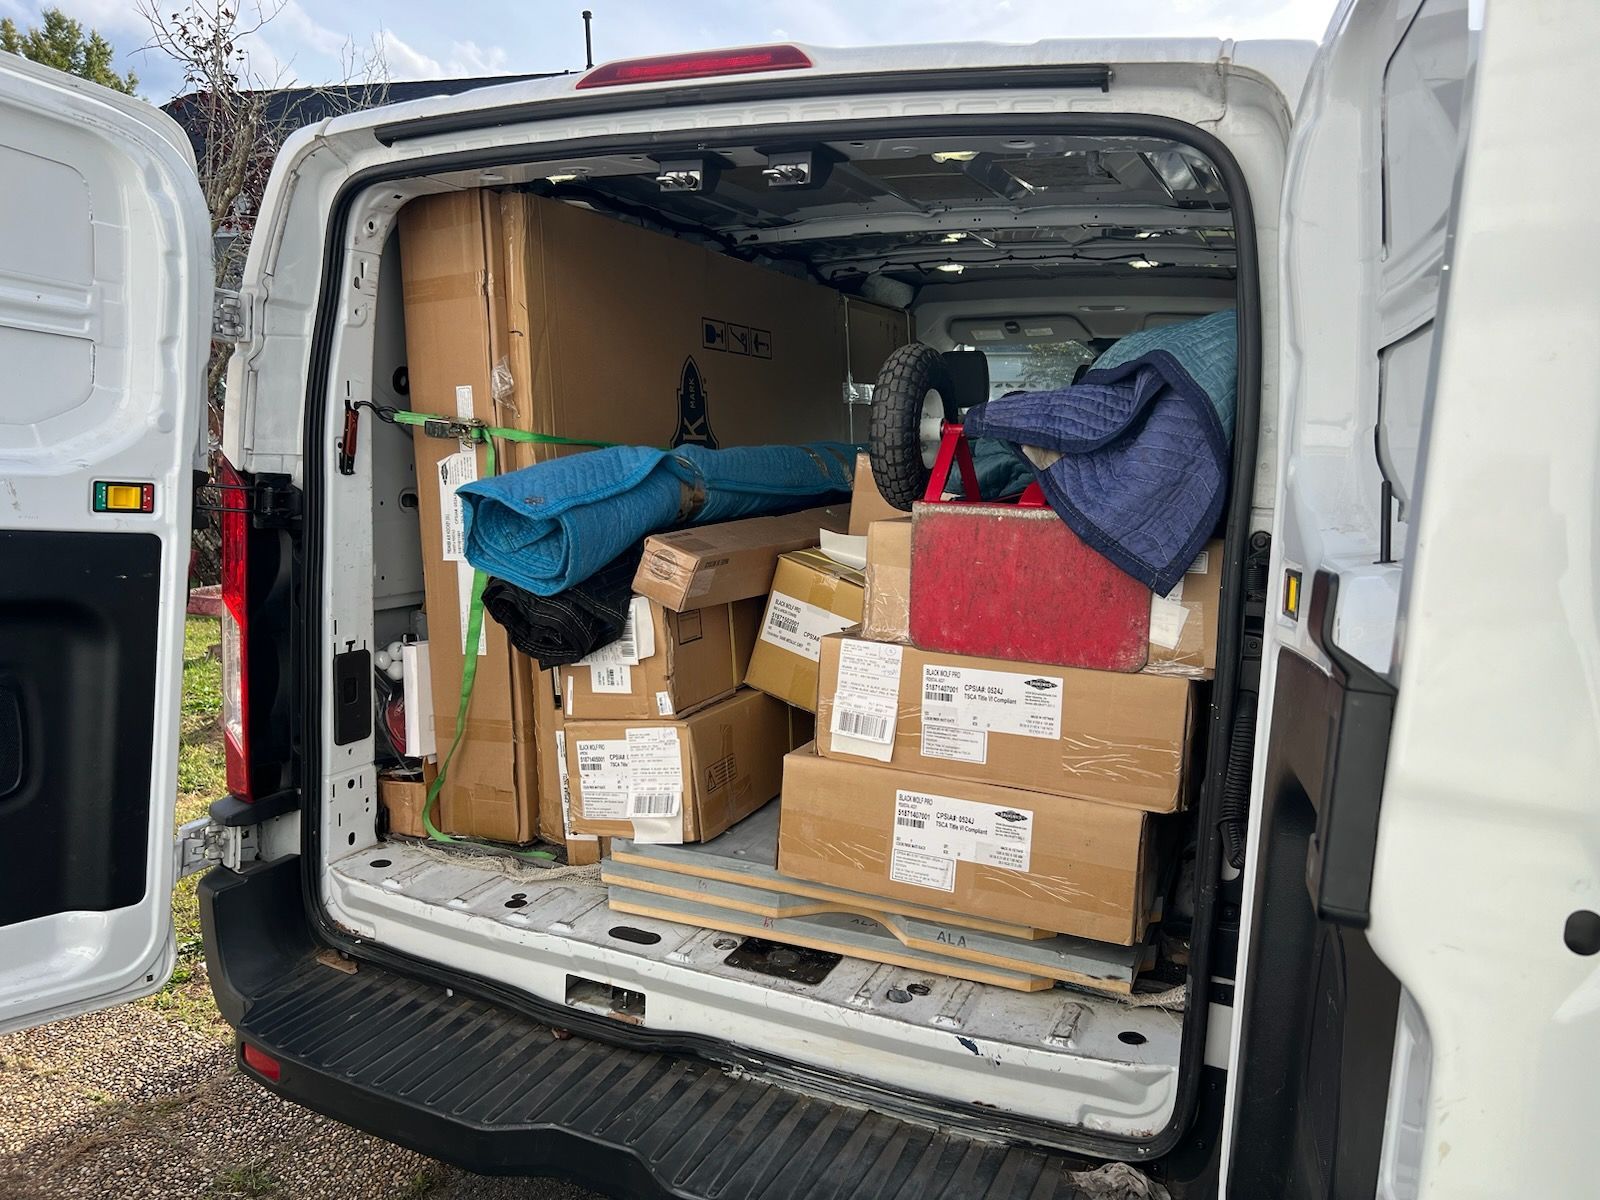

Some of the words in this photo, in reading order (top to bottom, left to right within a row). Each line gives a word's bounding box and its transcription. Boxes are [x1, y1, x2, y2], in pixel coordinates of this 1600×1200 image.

[688, 377, 697, 409] MARK
[775, 598, 786, 607] BLACK
[785, 602, 794, 610] WOLF
[926, 668, 940, 677] BLACK
[940, 669, 952, 678] WOLF
[952, 671, 961, 679] PRO
[926, 683, 959, 694] 51871407001
[964, 684, 987, 694] CPSIA#:
[987, 686, 1004, 696] 0524J
[964, 693, 977, 702] TSCA
[978, 694, 988, 702] Title
[993, 696, 1017, 705] Compliant
[899, 793, 912, 802] BLACK
[912, 795, 924, 804] WOLF
[924, 797, 933, 806] PRO
[898, 808, 930, 821] 51871407001
[935, 811, 958, 823] CPSIA#:
[958, 814, 975, 825] 0524J
[935, 820, 948, 829] TSCA
[949, 822, 959, 831] Title
[964, 825, 988, 835] Compliant
[937, 930, 967, 947] ALA
